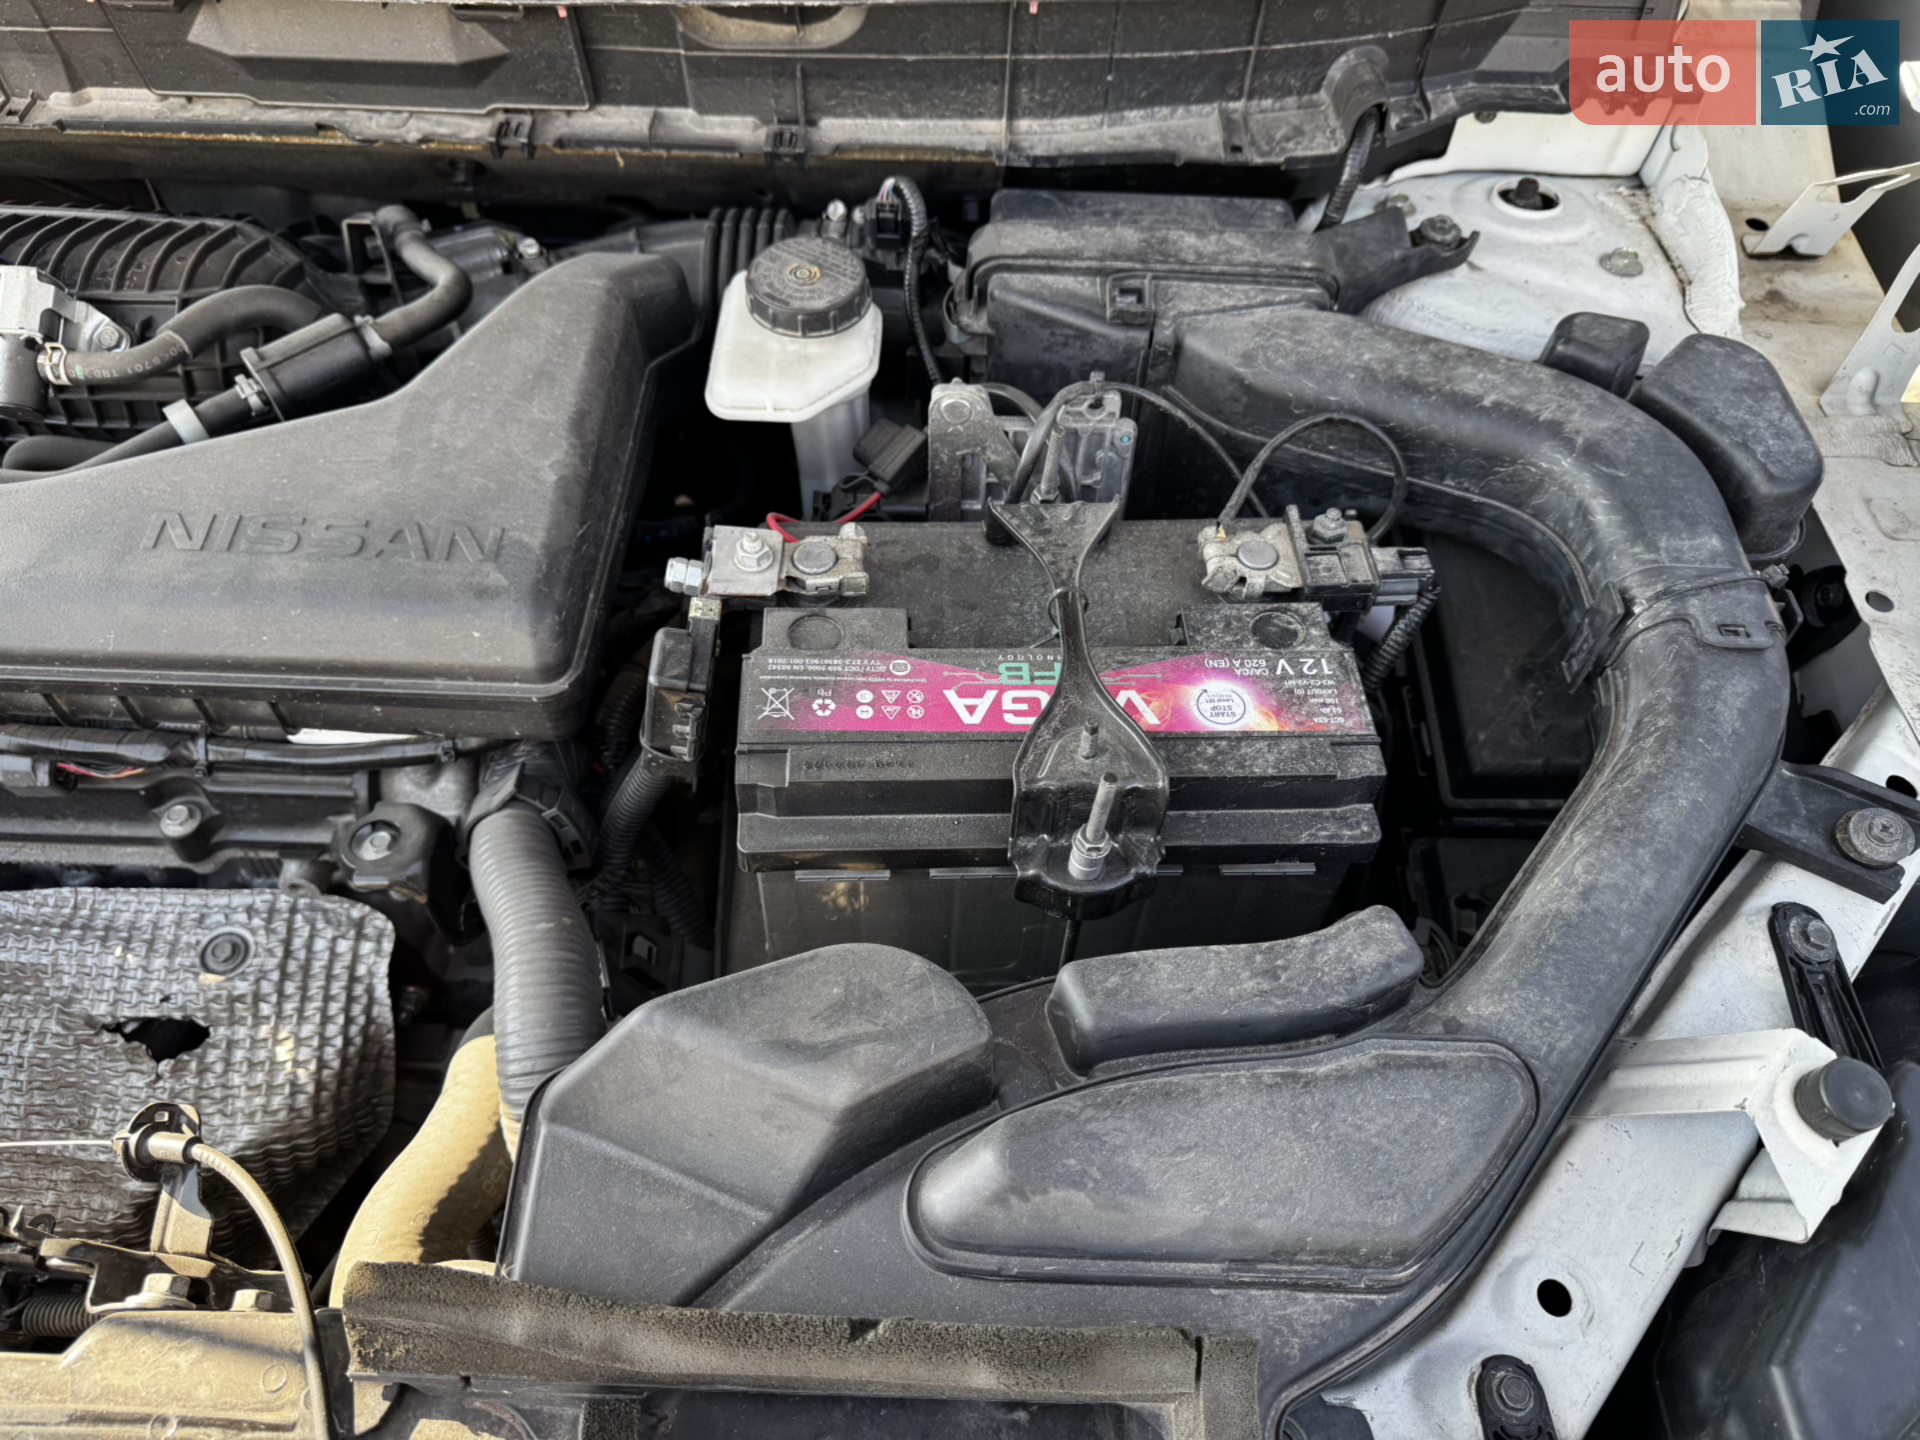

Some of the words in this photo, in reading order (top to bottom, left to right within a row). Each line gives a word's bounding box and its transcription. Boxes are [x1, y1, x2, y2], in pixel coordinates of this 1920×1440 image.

[139, 512, 506, 563] NISSAN
[1204, 658, 1230, 669] (EN)
[1232, 658, 1241, 668] A
[1245, 658, 1267, 668] 620
[1275, 658, 1295, 676] V
[1299, 658, 1334, 676] 12
[998, 662, 1062, 686] FB
[817, 688, 832, 697] Pb
[942, 690, 1161, 725] VGA
[1210, 704, 1233, 712] STOP
